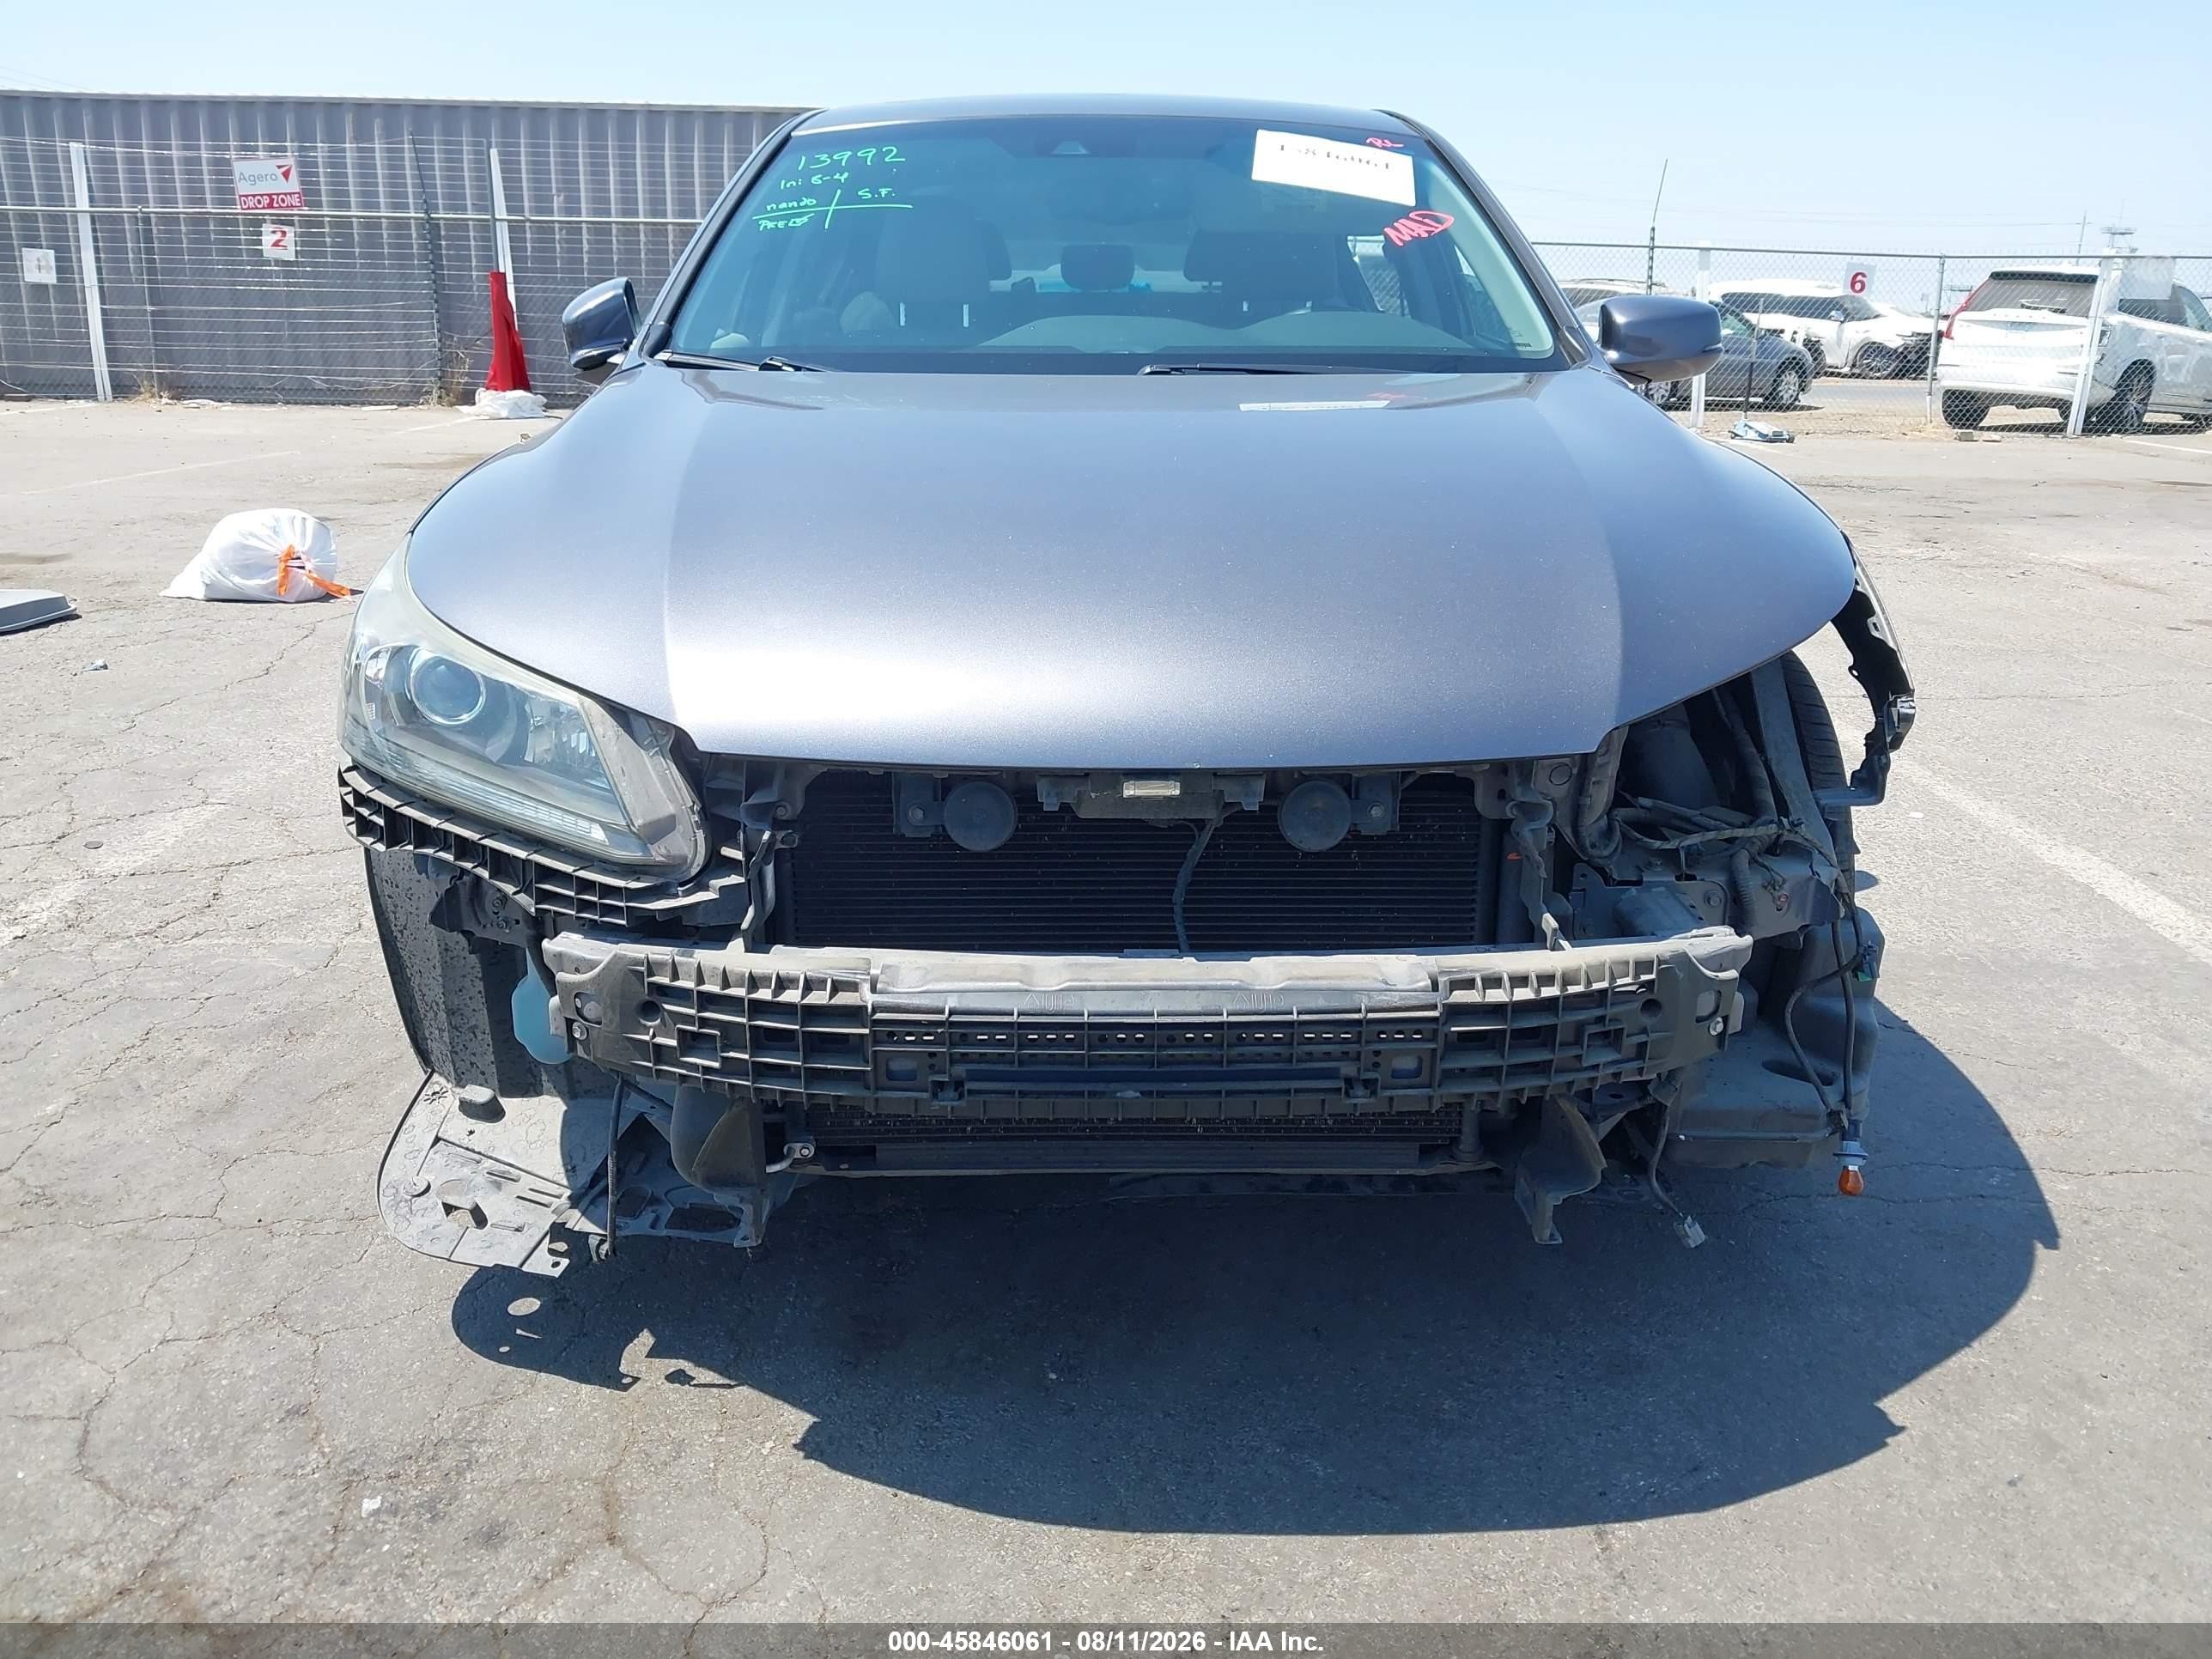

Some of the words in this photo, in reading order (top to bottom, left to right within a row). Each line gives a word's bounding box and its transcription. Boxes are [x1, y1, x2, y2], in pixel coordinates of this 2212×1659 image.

[797, 146, 906, 171] 13992
[238, 171, 278, 185] Agero
[241, 196, 270, 209] DROP
[272, 194, 301, 207] ZONE
[270, 228, 288, 250] 2
[1850, 270, 1869, 294] 6
